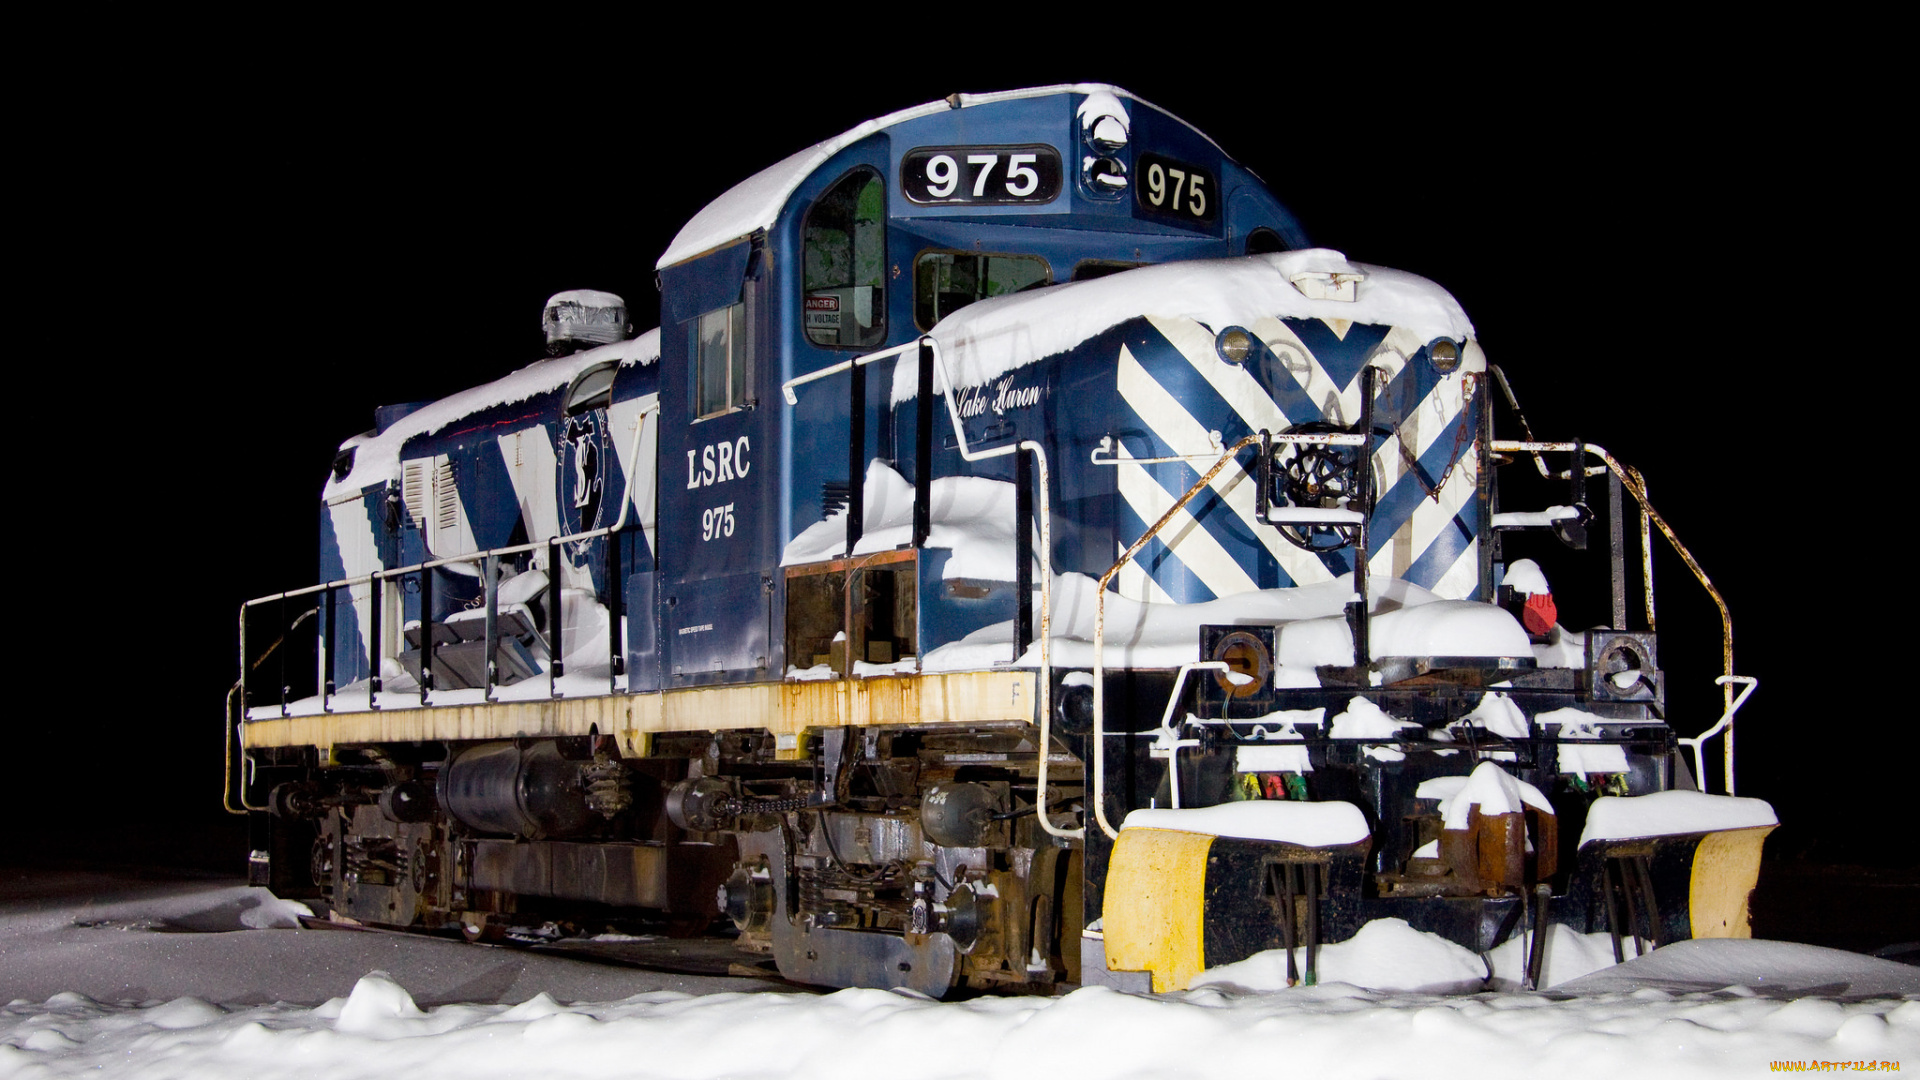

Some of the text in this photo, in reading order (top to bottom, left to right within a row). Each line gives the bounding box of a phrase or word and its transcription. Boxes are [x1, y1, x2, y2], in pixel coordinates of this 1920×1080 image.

[926, 154, 1038, 198] 975
[1148, 163, 1206, 217] 975
[804, 299, 836, 309] ANGER
[814, 314, 839, 324] VOLTAGE
[956, 374, 1043, 418] Lake Huron
[687, 436, 751, 490] LSRC
[702, 502, 735, 542] 975
